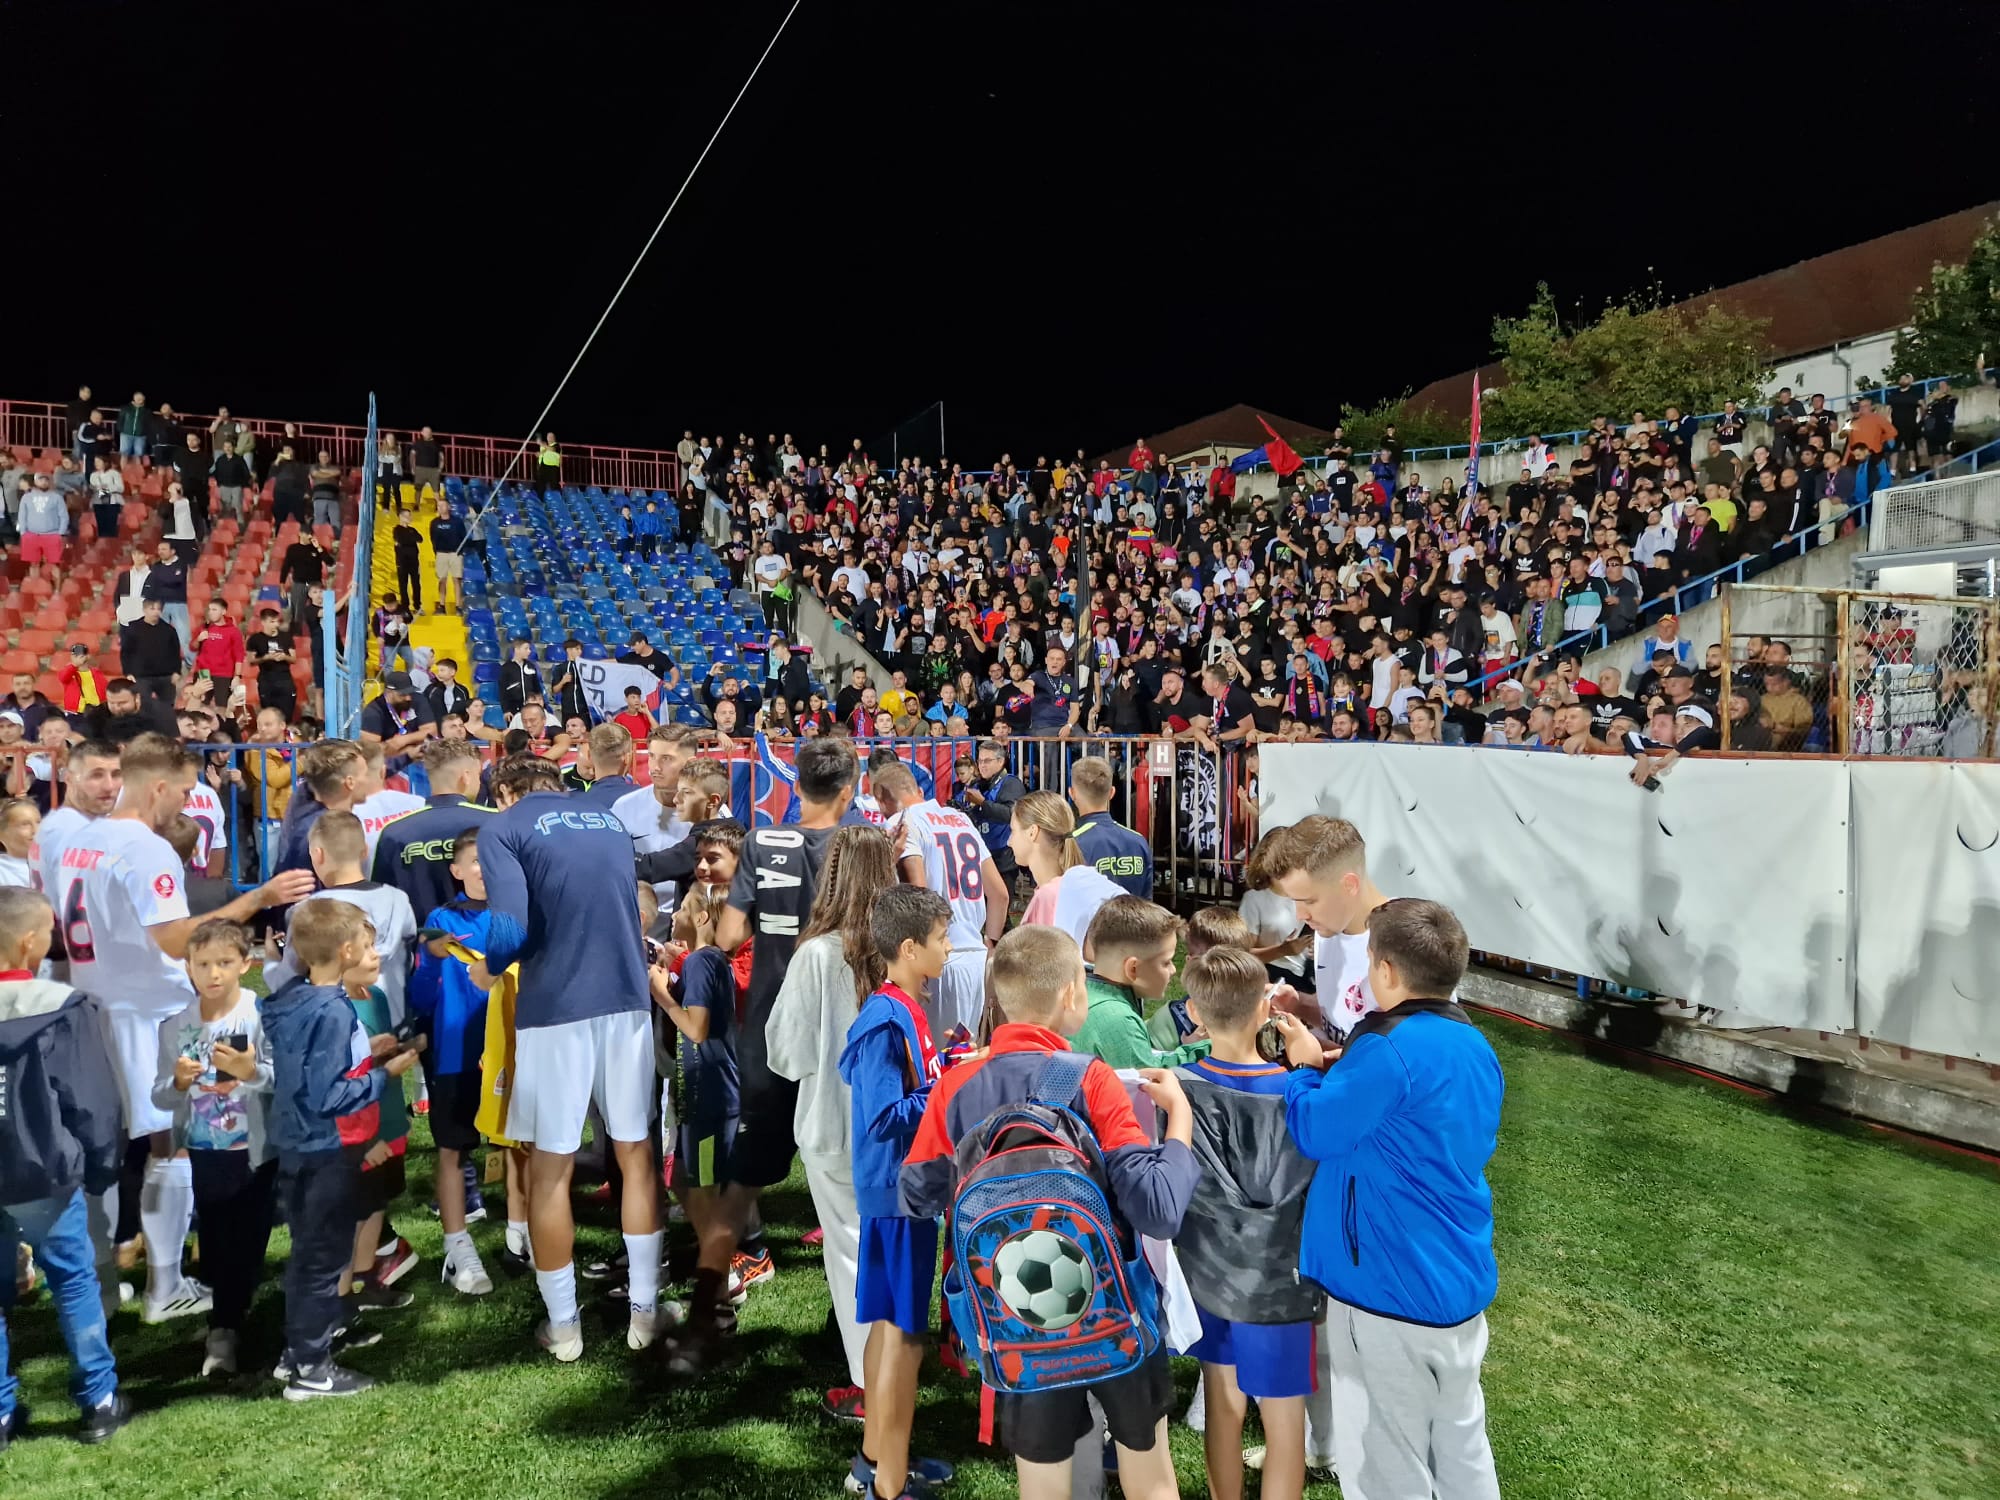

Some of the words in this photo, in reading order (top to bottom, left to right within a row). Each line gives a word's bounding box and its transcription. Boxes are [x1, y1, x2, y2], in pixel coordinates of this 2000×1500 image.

[1156, 744, 1169, 764] H
[534, 811, 624, 836] FCSB
[400, 839, 456, 864] FCS
[932, 831, 984, 901] 18
[63, 877, 97, 964] 6
